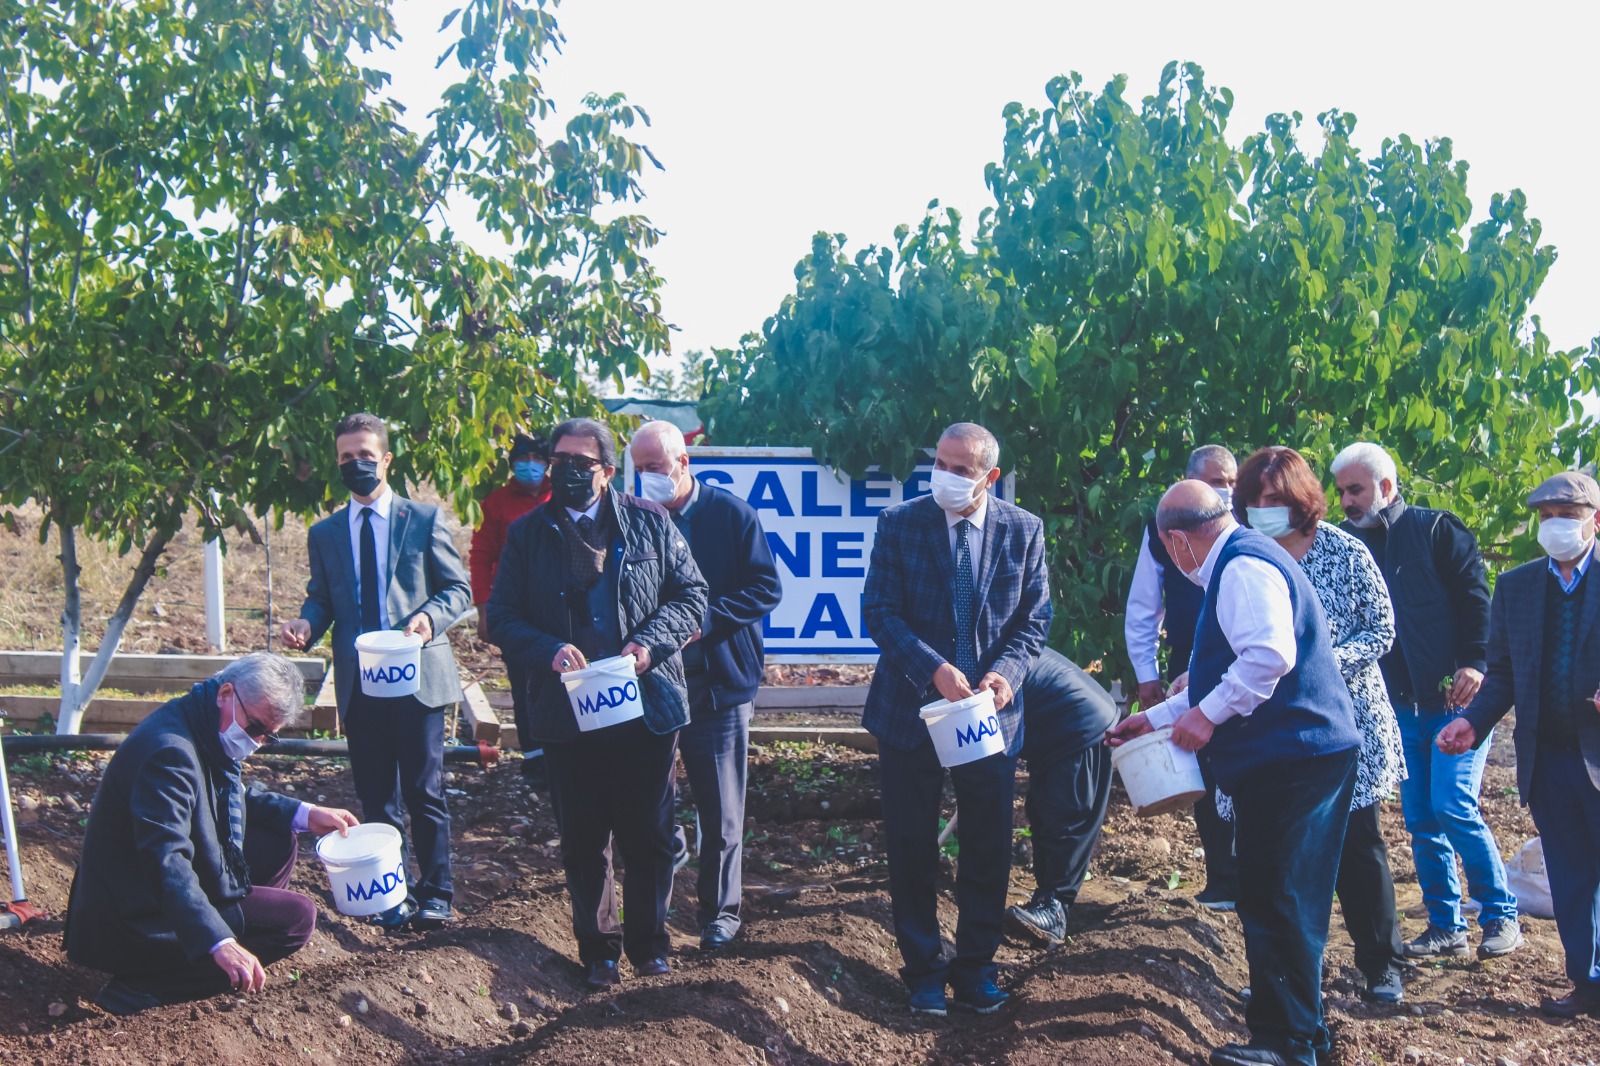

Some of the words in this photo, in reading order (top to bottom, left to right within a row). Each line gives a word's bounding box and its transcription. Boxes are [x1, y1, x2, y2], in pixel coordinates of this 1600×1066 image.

[764, 532, 877, 577] NE
[363, 663, 416, 683] MADO
[577, 681, 637, 716] MADO
[956, 715, 999, 748] MAD
[346, 862, 403, 901] MADO
